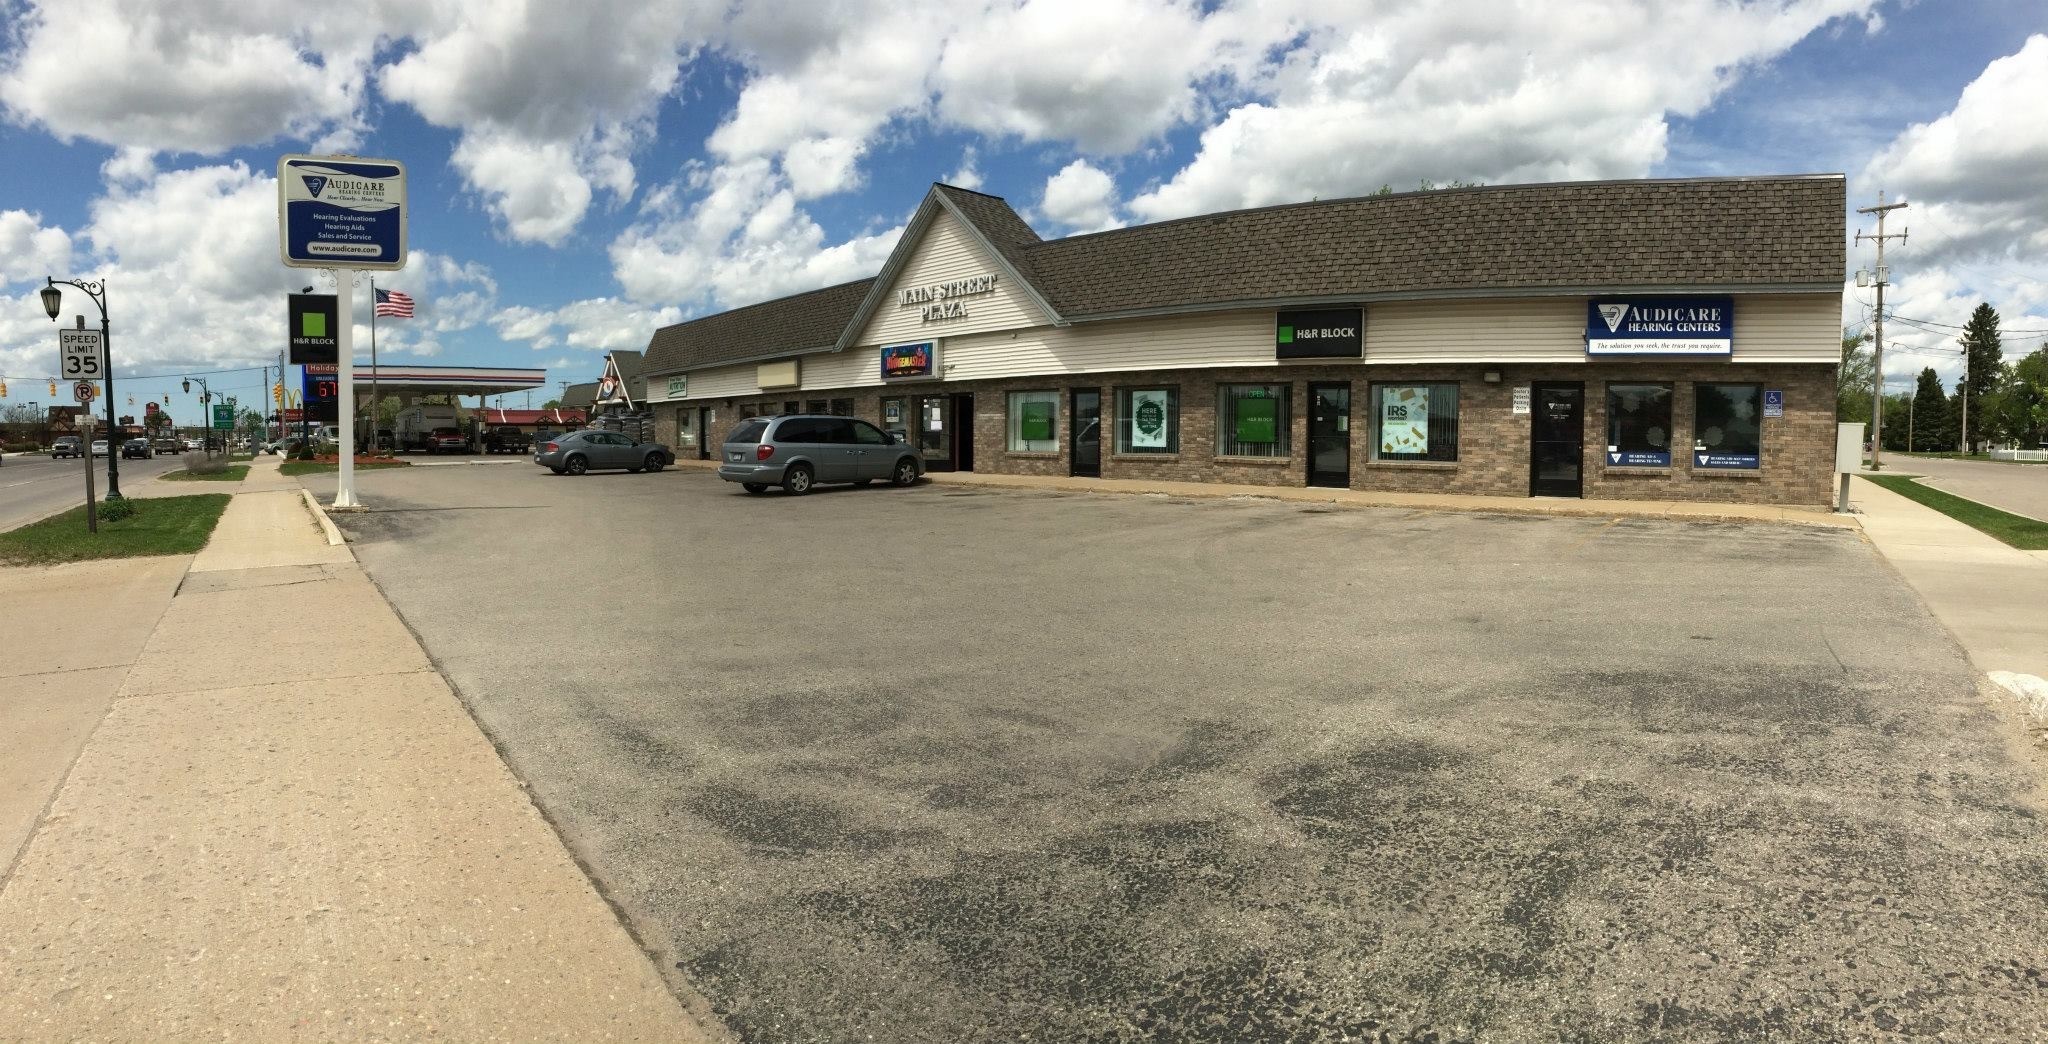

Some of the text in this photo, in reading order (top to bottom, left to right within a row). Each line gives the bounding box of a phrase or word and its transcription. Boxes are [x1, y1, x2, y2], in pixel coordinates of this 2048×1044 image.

[327, 179, 385, 191] AUDICARE
[313, 213, 339, 222] Hearing
[312, 245, 377, 253] www.audicare.com
[898, 274, 997, 306] MAIN STREET
[921, 301, 968, 322] PLAZA
[1629, 306, 1721, 322] AUDICARE
[1628, 322, 1721, 332] HEARING CENTERS
[1297, 327, 1355, 339] H&R BLOCK
[63, 335, 98, 344] SPEED
[67, 345, 94, 354] LIMIT
[1700, 342, 1723, 351] require.
[67, 355, 98, 374] 35
[310, 364, 340, 372] Holiday
[1249, 390, 1265, 398] OPEN
[1387, 405, 1408, 416] IRS
